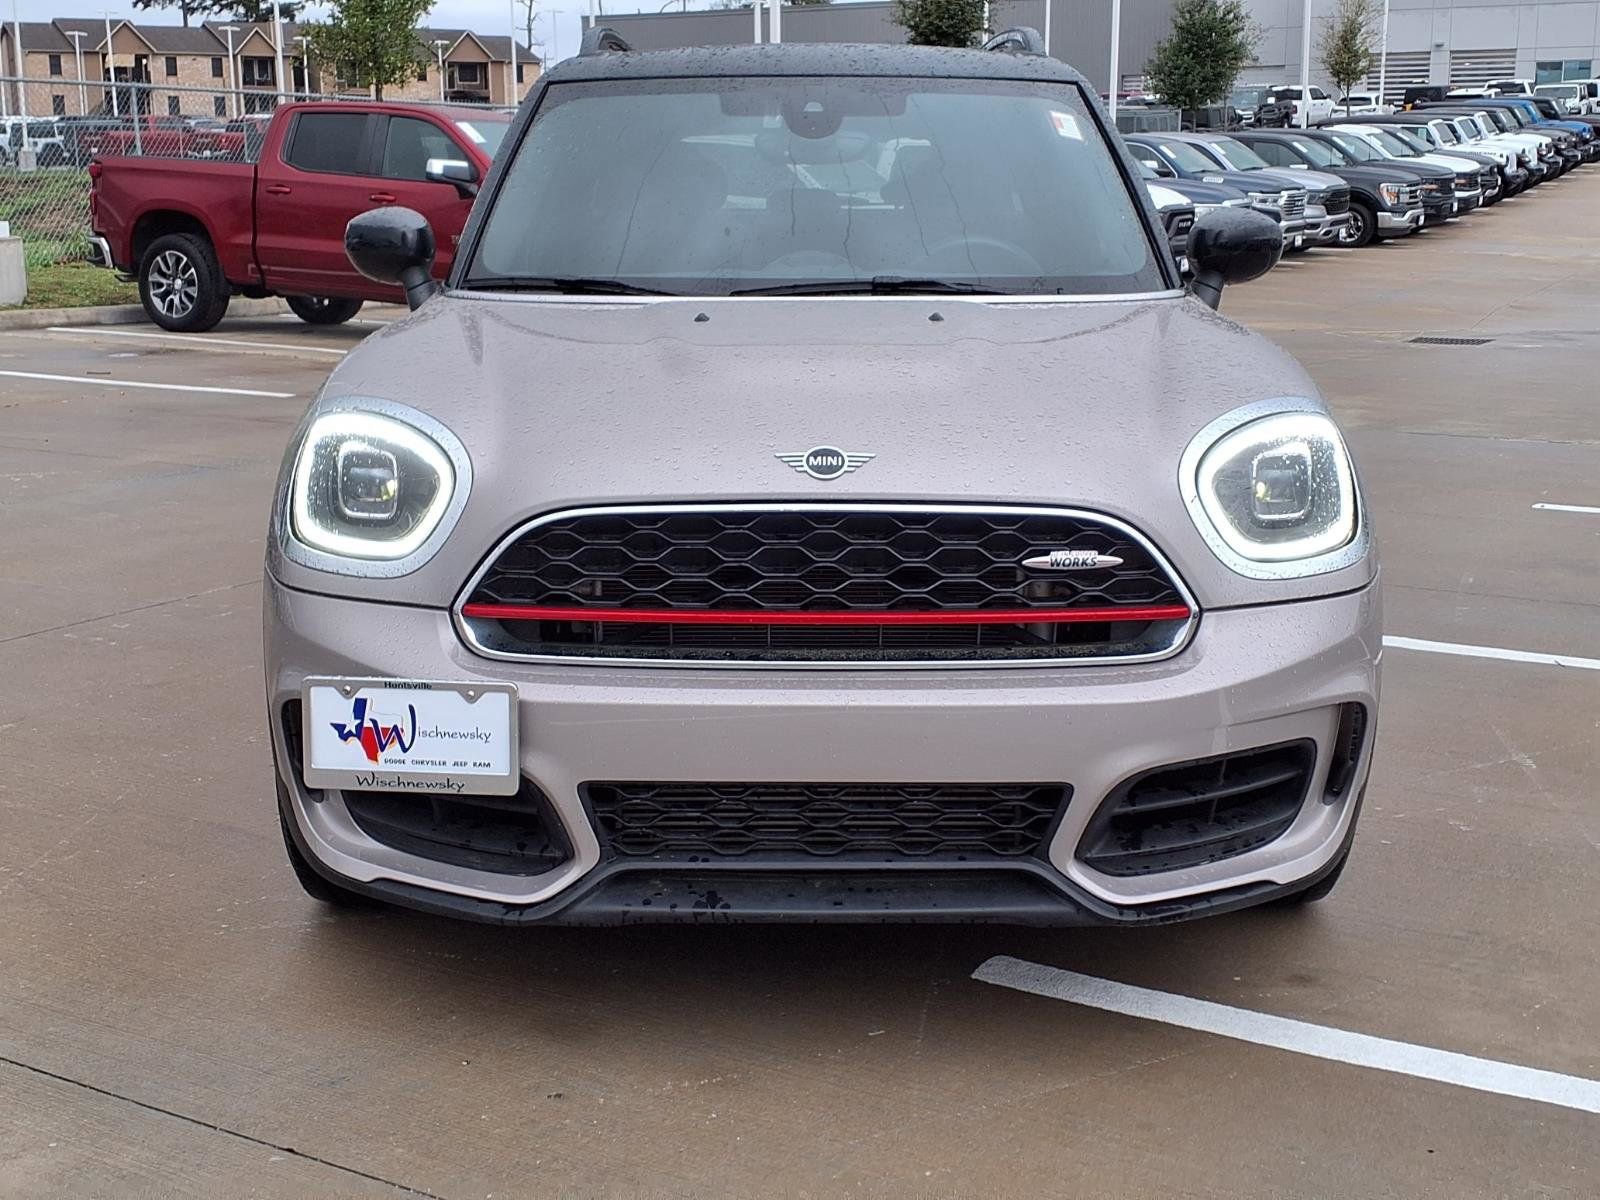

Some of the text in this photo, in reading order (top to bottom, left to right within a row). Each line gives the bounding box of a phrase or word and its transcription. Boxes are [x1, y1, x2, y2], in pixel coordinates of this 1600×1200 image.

[808, 456, 842, 466] MINI
[1050, 557, 1097, 567] WORKS
[384, 681, 432, 690] Huntsville
[368, 704, 492, 753] Wischnewsky
[355, 772, 465, 792] Wischnewsky
